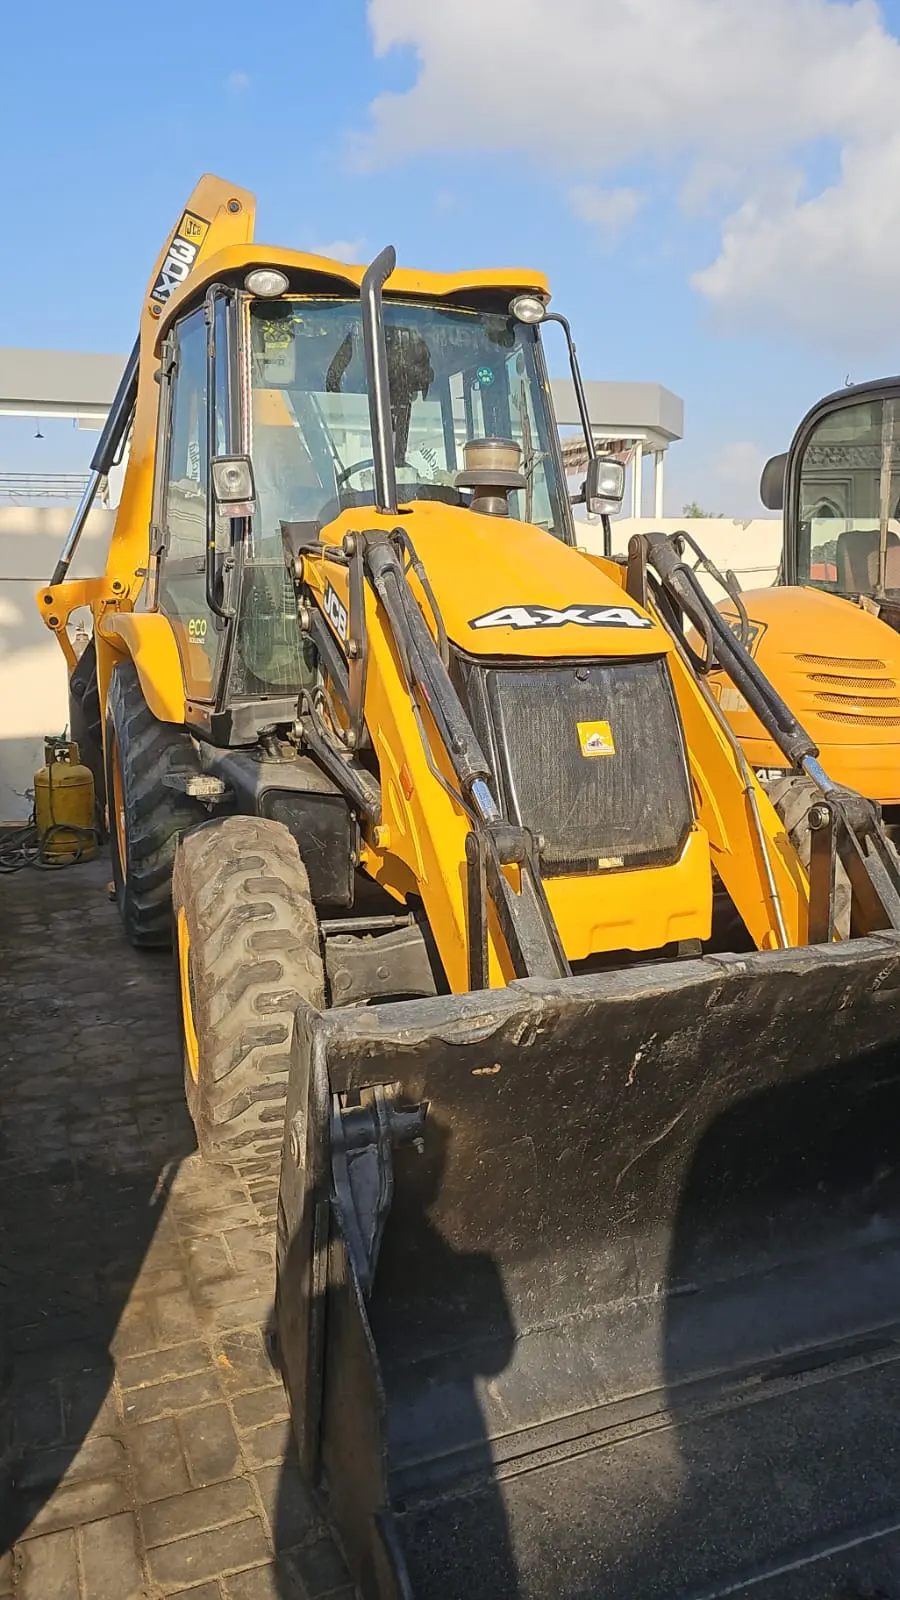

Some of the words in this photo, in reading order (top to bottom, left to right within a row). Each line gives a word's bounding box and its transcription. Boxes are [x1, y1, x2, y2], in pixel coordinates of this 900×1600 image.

[187, 220, 202, 235] JCB
[156, 239, 197, 296] 3DX
[188, 618, 207, 636] eco
[324, 586, 347, 641] JCB
